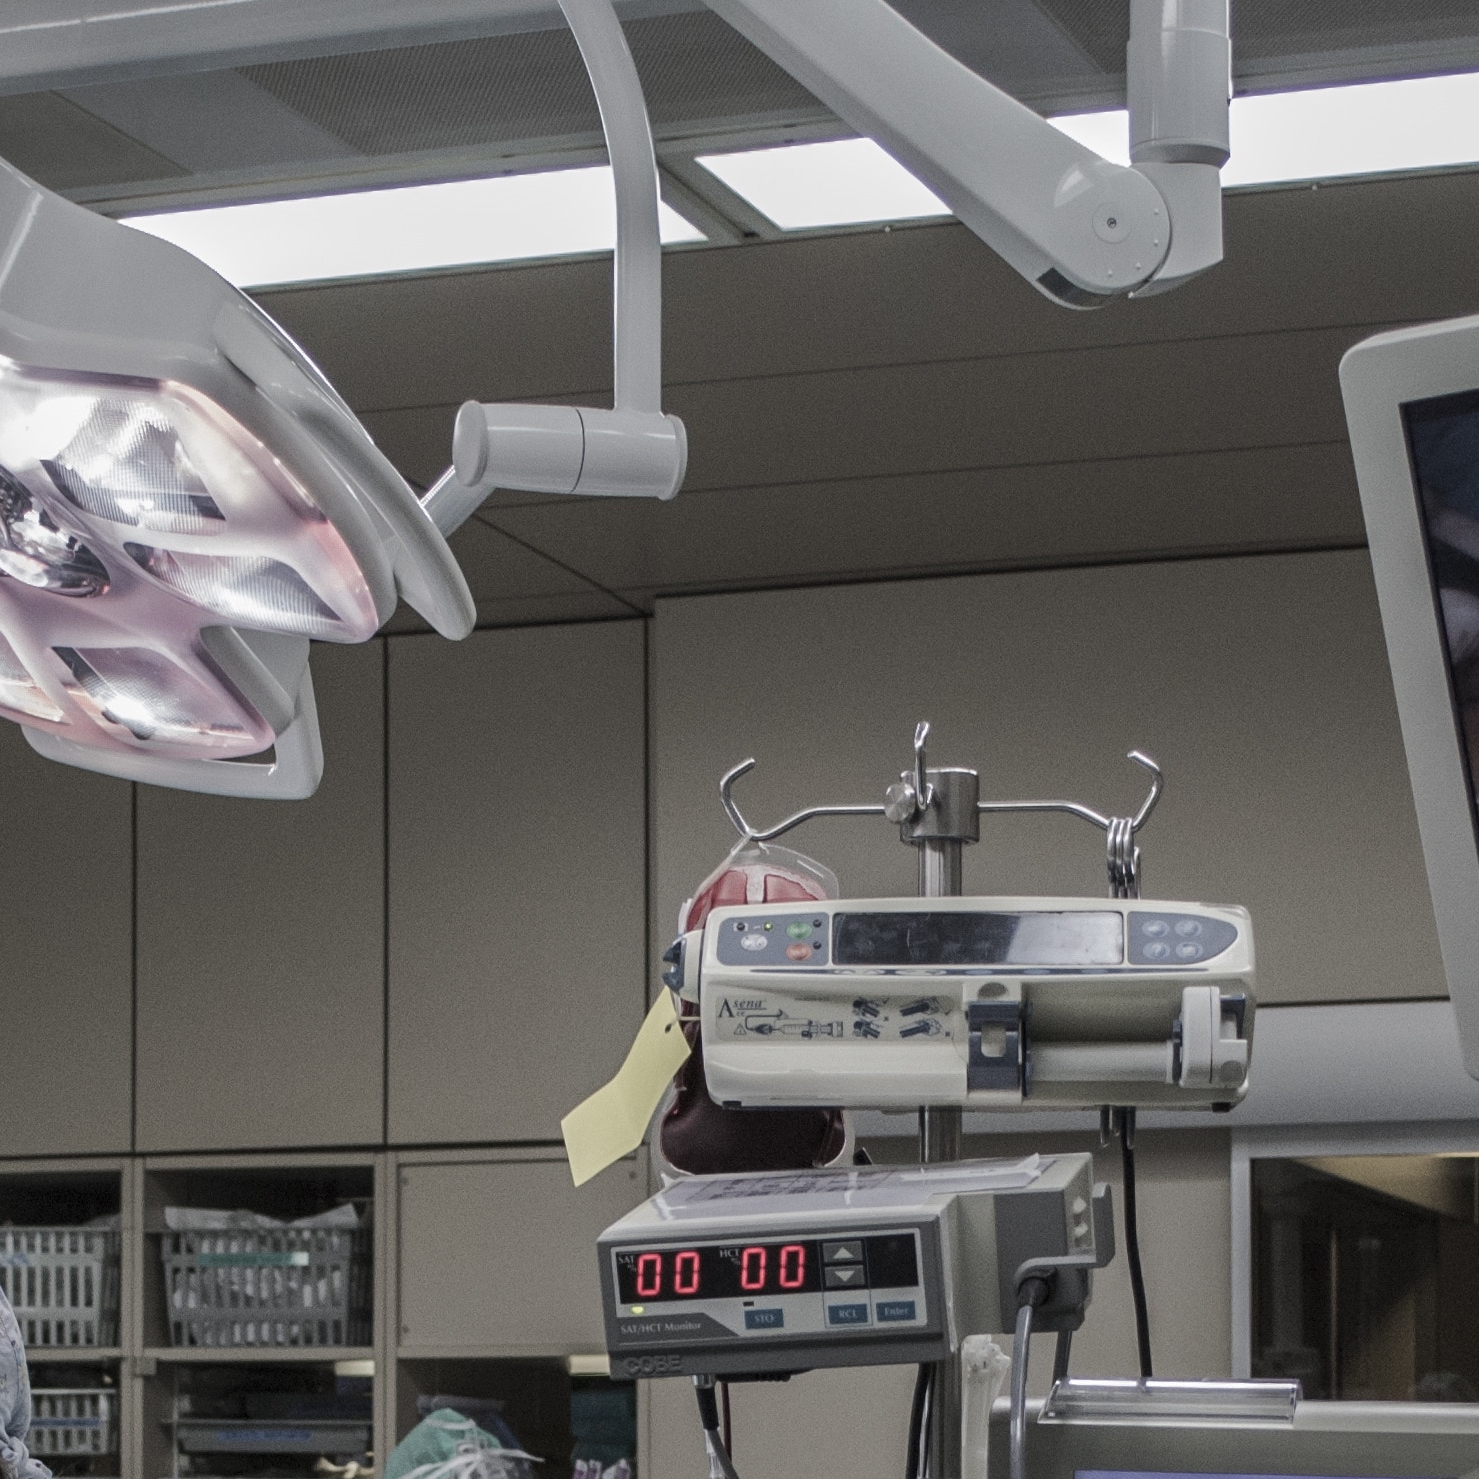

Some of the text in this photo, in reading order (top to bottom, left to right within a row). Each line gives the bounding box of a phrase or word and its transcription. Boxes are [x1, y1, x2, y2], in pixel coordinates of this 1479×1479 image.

[719, 1247, 740, 1259] HCT
[618, 1255, 636, 1266] SAT
[838, 1309, 857, 1320] RCL
[884, 1306, 909, 1317] Enter
[620, 1320, 702, 1335] SAT/HCT Monitor
[622, 1355, 682, 1375] COBE
